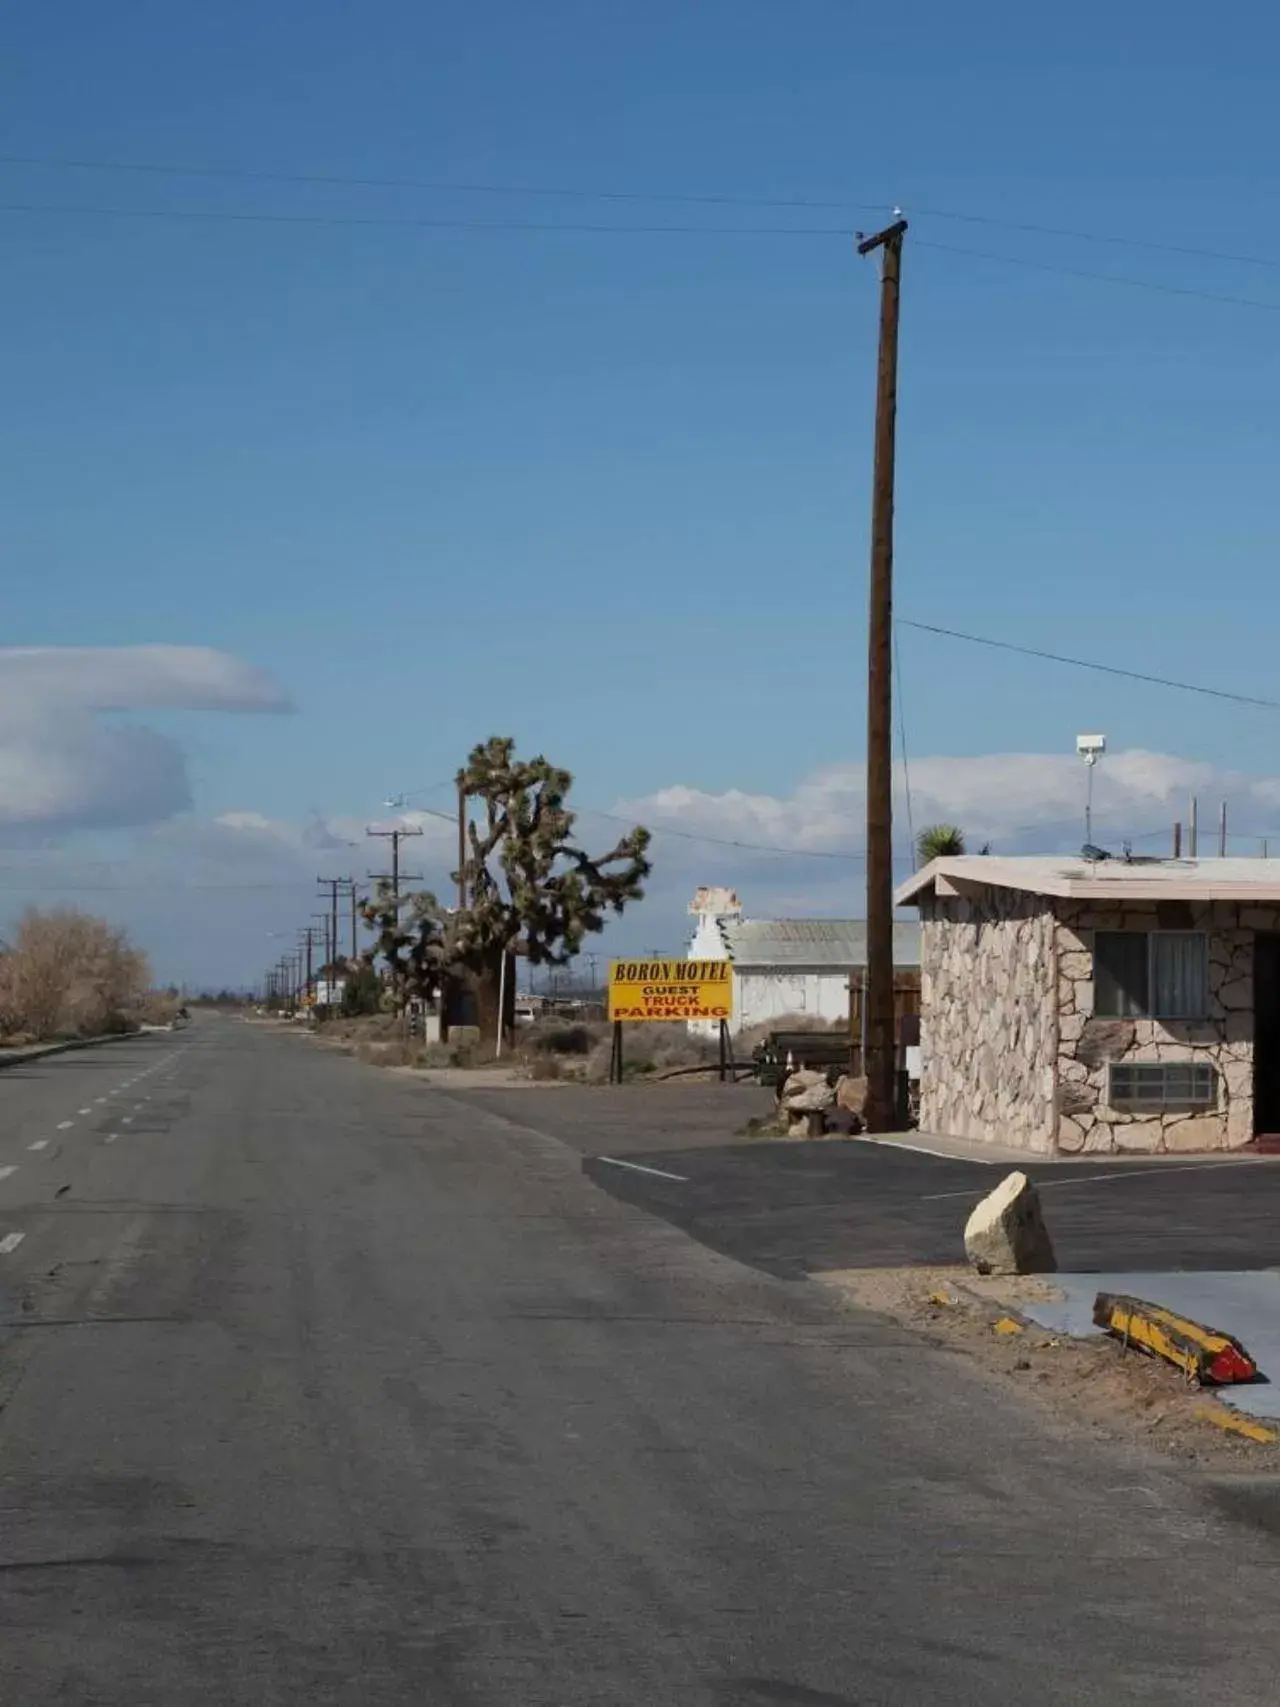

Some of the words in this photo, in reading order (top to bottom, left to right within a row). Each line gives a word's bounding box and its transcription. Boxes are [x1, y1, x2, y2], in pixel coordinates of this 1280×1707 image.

[615, 963, 671, 981] BORON
[675, 962, 729, 981] MOTEL
[643, 986, 700, 995] GUEST
[642, 996, 700, 1006] TRUCK
[614, 1007, 729, 1017] PARKING
